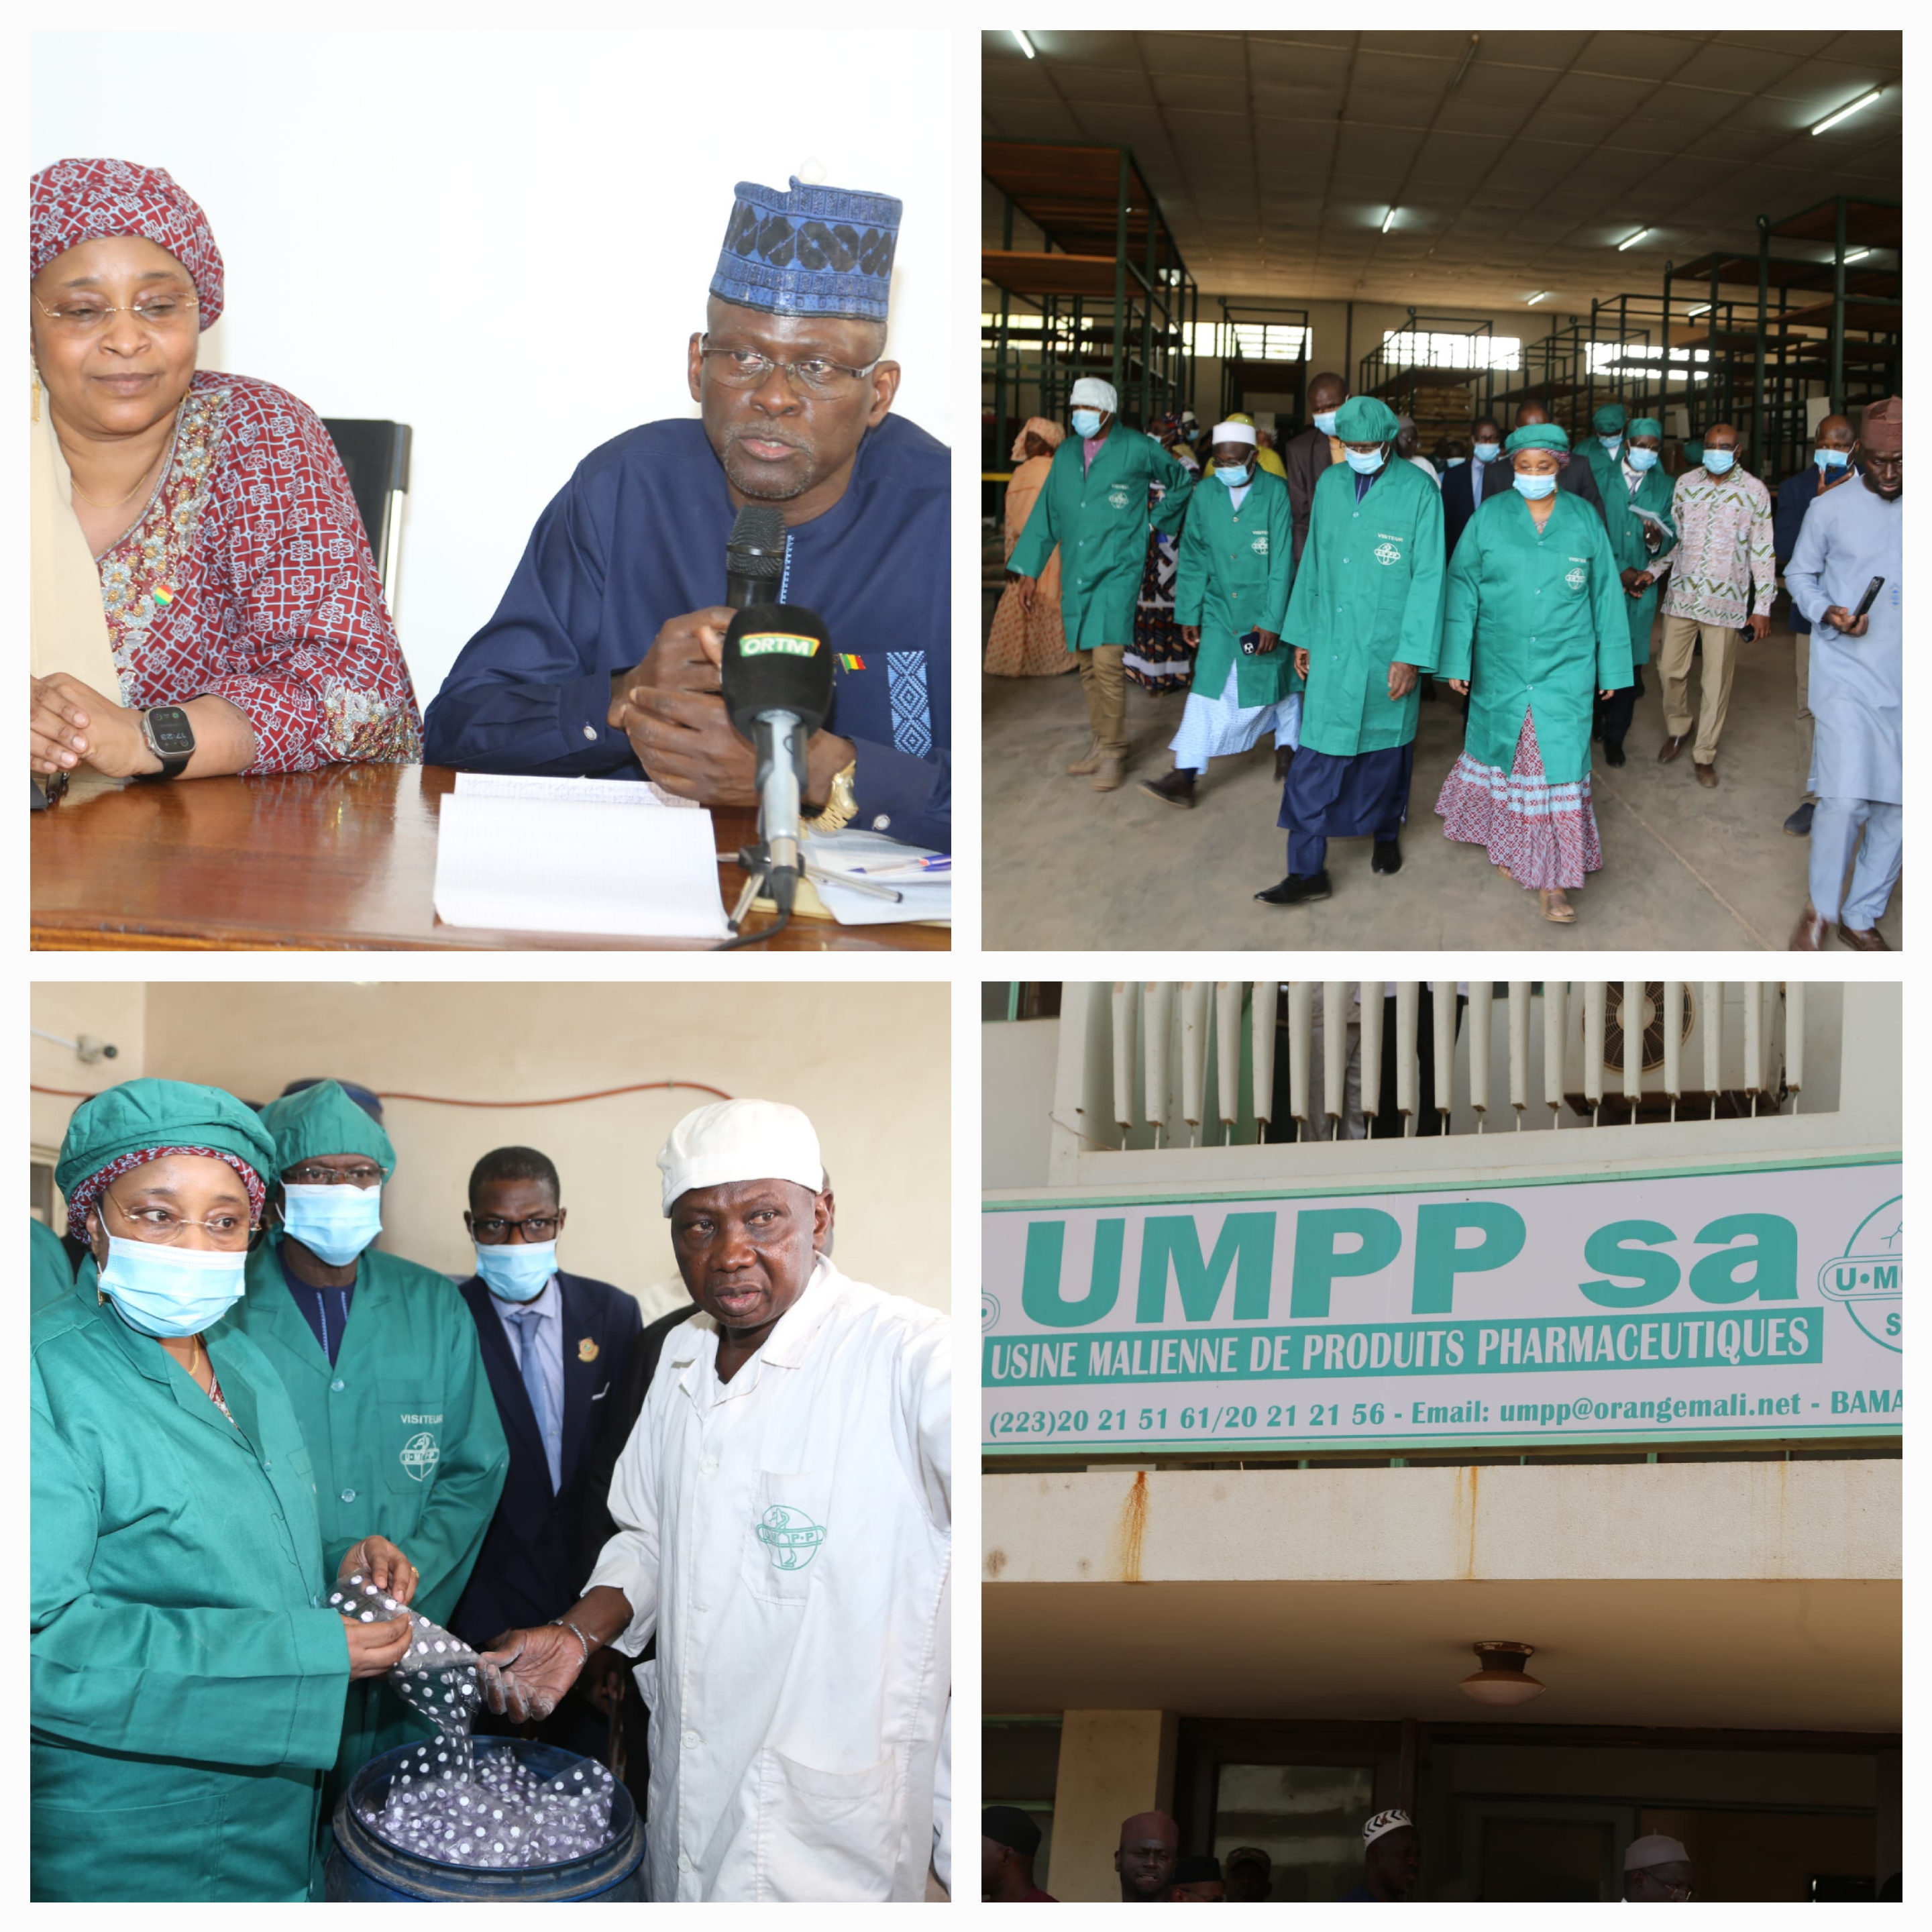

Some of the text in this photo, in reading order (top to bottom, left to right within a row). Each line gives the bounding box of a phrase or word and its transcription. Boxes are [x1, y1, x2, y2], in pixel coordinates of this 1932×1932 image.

[743, 637, 810, 655] ORTM
[1021, 1201, 1800, 1328] UMPP sa
[991, 1317, 1810, 1380] USINE MALIENNE DE PRODUITS PHARMACEUTIQUES
[400, 1413, 443, 1424] VISITEUR
[989, 1409, 1089, 1438] (223)20
[1097, 1409, 1126, 1431] 21
[1138, 1408, 1168, 1430] 51
[1179, 1405, 1258, 1434] 61/20
[1267, 1405, 1296, 1427] 21
[1309, 1404, 1339, 1426] 21
[1352, 1403, 1385, 1426] 56
[1411, 1400, 1489, 1424] Email:
[1499, 1393, 1802, 1426] umpp@orangemali.net
